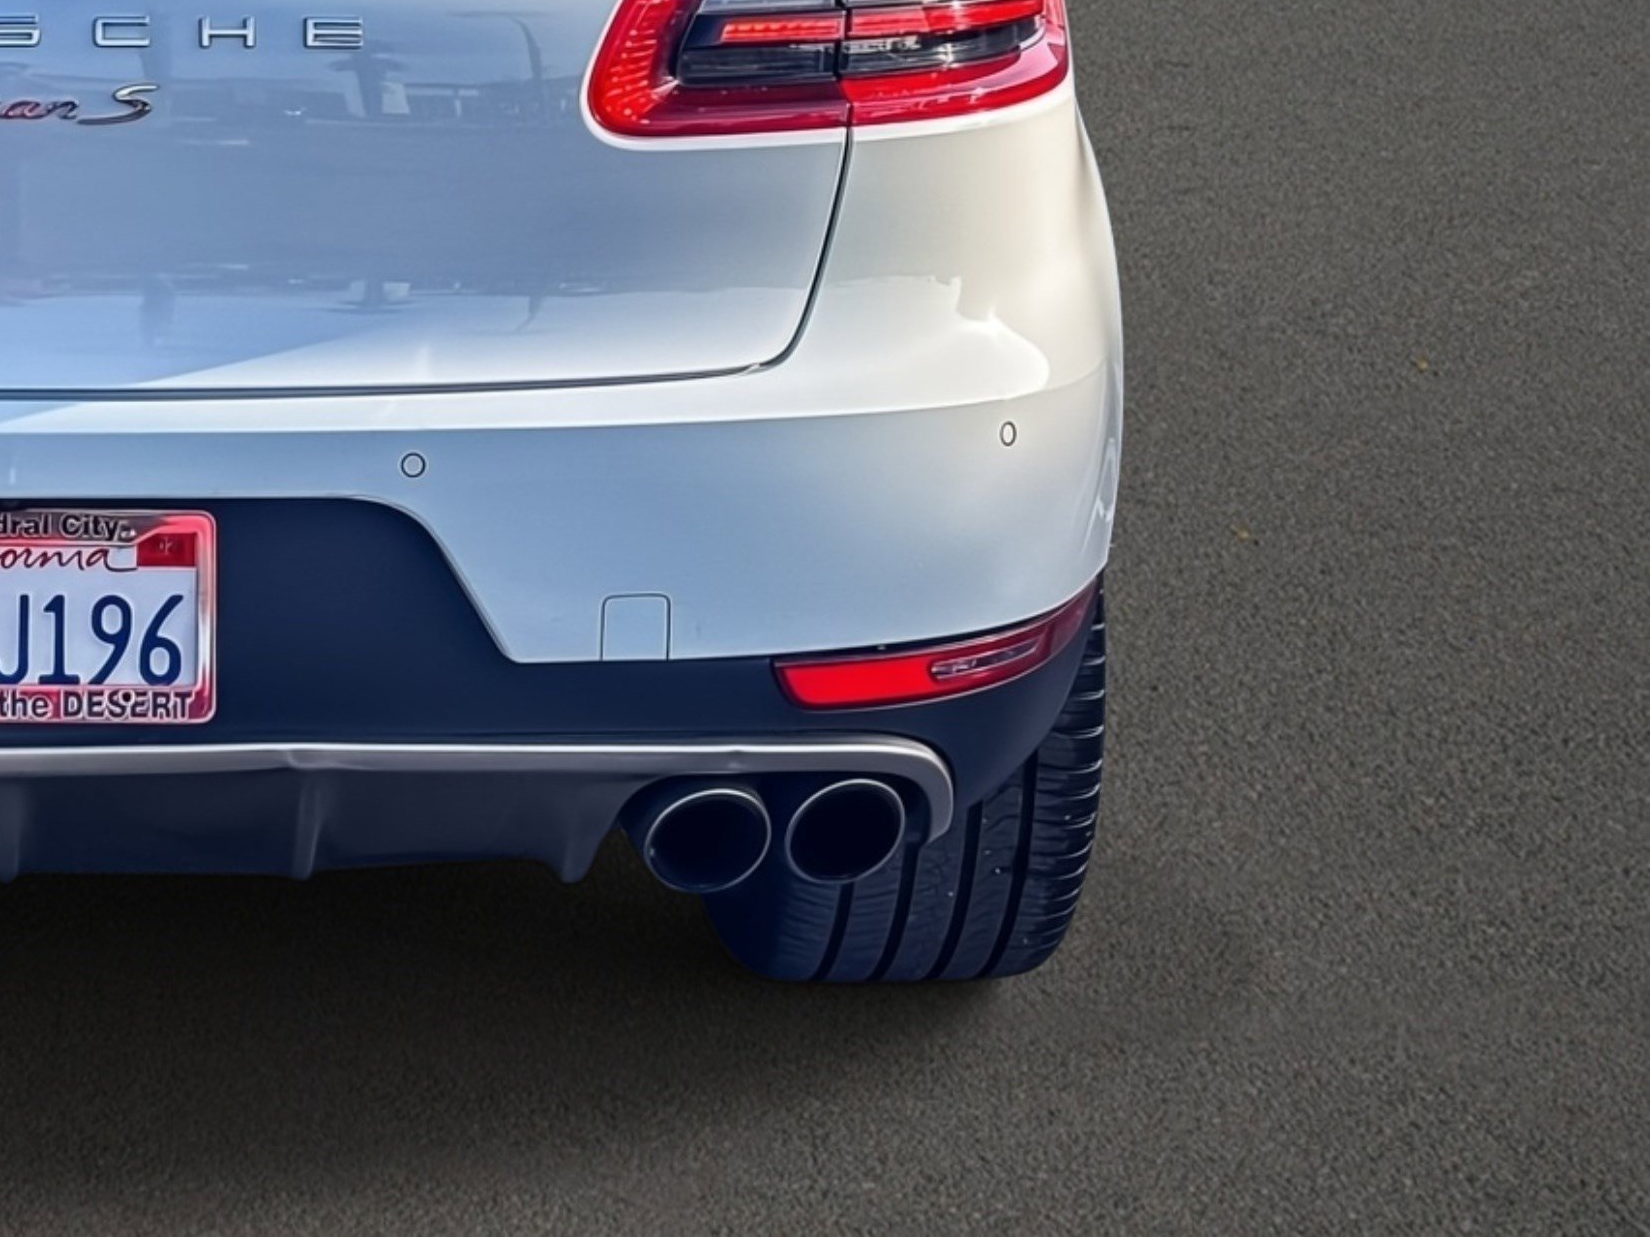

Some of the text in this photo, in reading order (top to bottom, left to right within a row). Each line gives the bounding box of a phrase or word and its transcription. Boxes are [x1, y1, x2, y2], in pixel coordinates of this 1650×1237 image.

[77, 83, 159, 125] S
[60, 513, 122, 540] City
[63, 690, 193, 720] DESERT
